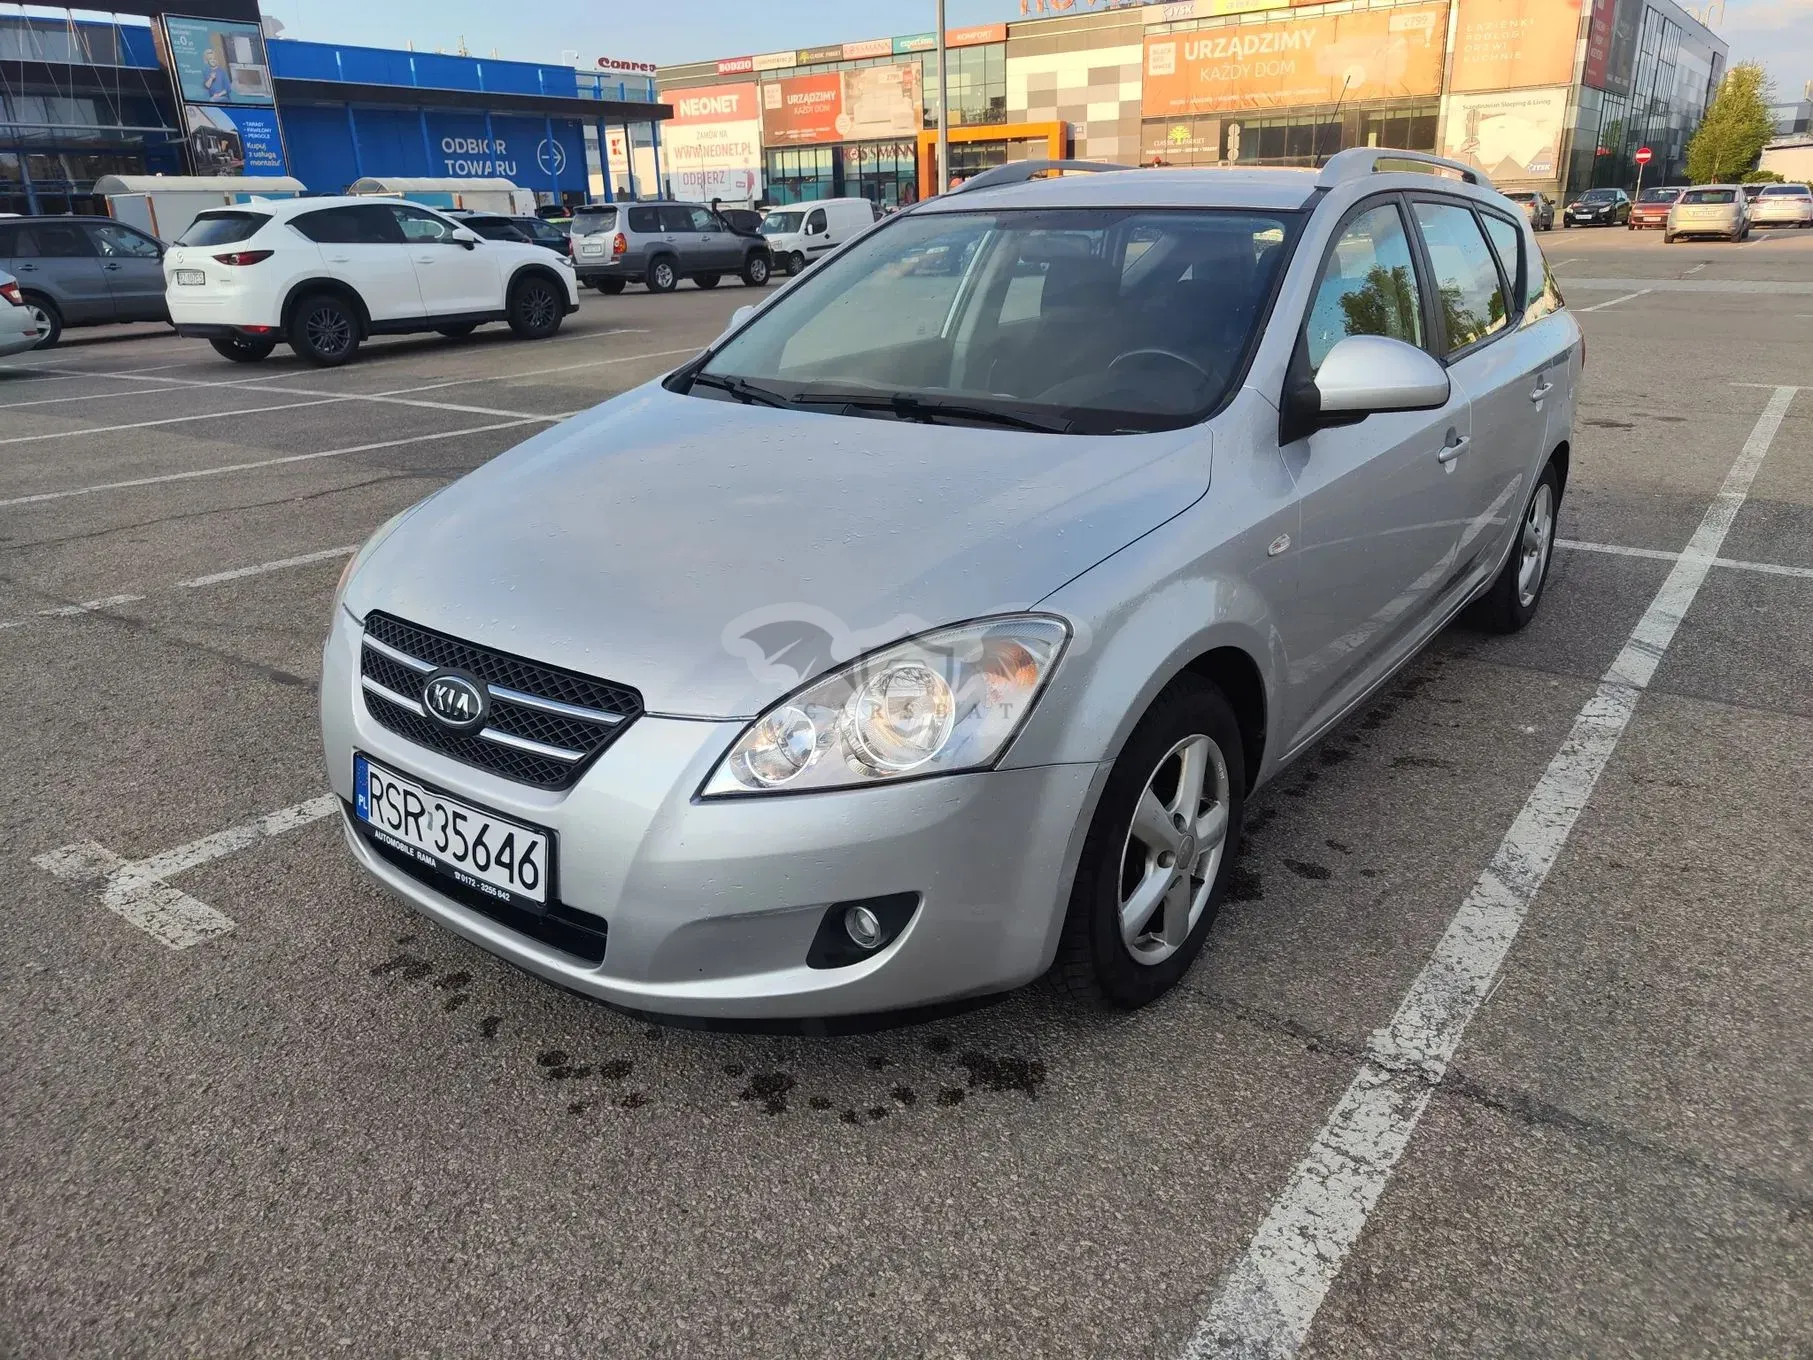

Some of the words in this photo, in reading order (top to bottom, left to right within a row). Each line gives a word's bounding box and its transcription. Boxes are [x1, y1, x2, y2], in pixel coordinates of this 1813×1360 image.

[1184, 27, 1317, 61] URZĄDZIMY
[718, 60, 752, 72] BODZIO
[1200, 62, 1252, 81] KAŻDY
[1254, 60, 1296, 78] DOM
[680, 94, 738, 116] NEONET
[786, 90, 836, 106] URZĄDZIMY
[444, 160, 517, 176] TOWARU
[682, 170, 726, 186] ODBIERZ
[433, 684, 470, 719] KIA
[358, 794, 368, 810] PL
[370, 772, 426, 842] RSR
[434, 803, 539, 890] 35646
[374, 829, 414, 857] AUTOMOBILE
[416, 851, 436, 868] RAMA
[460, 872, 476, 887] 0172
[480, 882, 497, 897] 3255
[497, 889, 510, 902] 842
